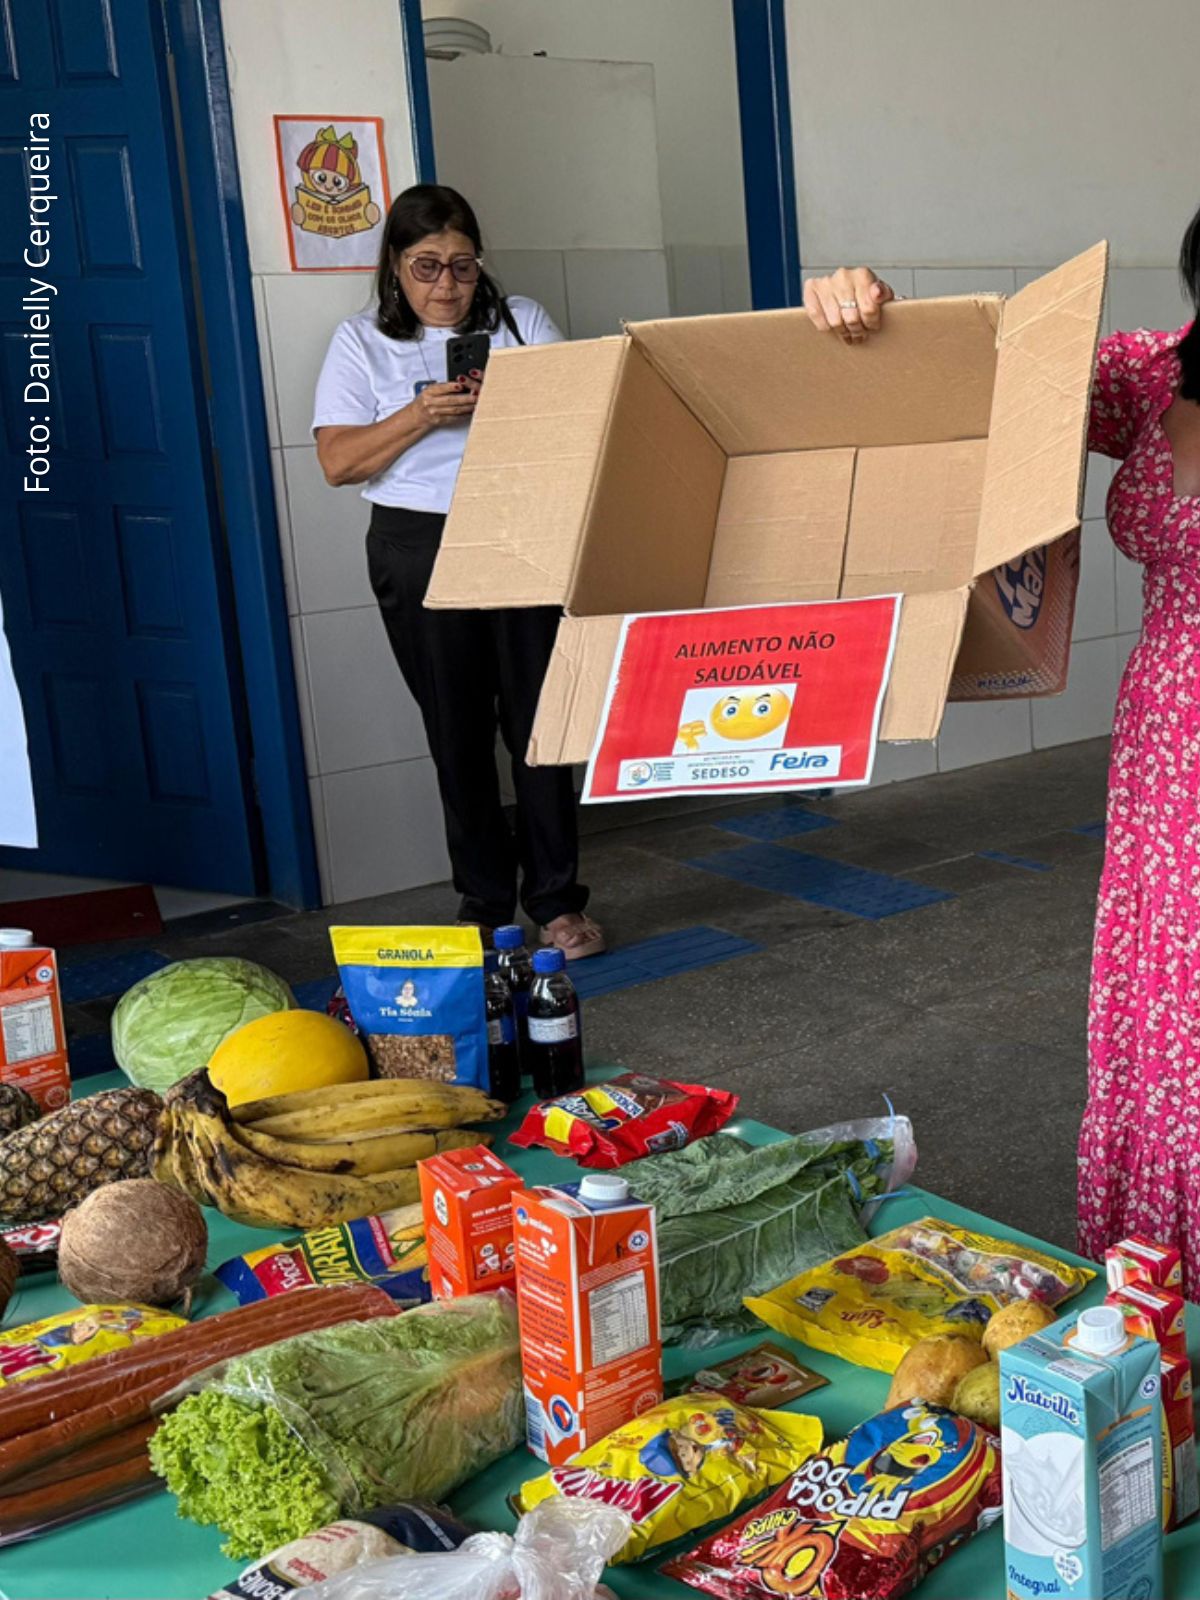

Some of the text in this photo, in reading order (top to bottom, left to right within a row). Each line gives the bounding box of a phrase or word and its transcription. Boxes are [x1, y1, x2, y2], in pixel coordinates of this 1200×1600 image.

[675, 631, 836, 659] ALIMENTO NÃO
[694, 660, 803, 684] SAUDÁVEL
[692, 766, 749, 779] SEDESO
[769, 752, 829, 771] Feira
[377, 949, 434, 960] GRANOLA
[1007, 1375, 1080, 1424] Natville
[787, 1478, 909, 1520] PIPOCA
[742, 1509, 799, 1540] CHIPS
[1008, 1565, 1061, 1596] Integral
